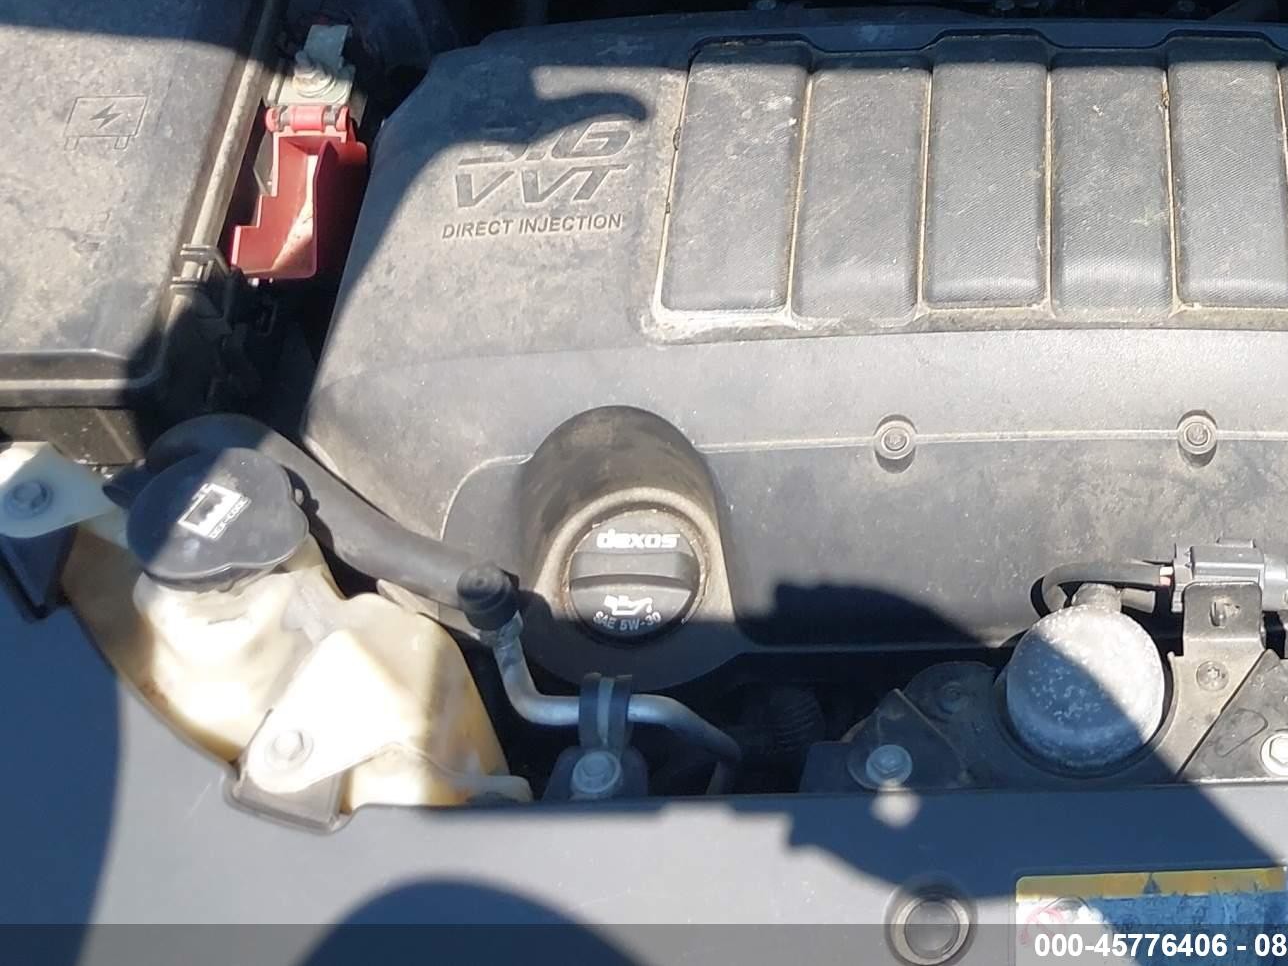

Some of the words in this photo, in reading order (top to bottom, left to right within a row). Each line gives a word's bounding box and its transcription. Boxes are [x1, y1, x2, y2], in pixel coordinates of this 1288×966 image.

[454, 164, 632, 208] VVT
[441, 218, 514, 240] DIRECT
[518, 212, 624, 235] INJECTION
[597, 530, 681, 548] dexos
[593, 612, 617, 629] SAE
[620, 612, 661, 631] 5W-30
